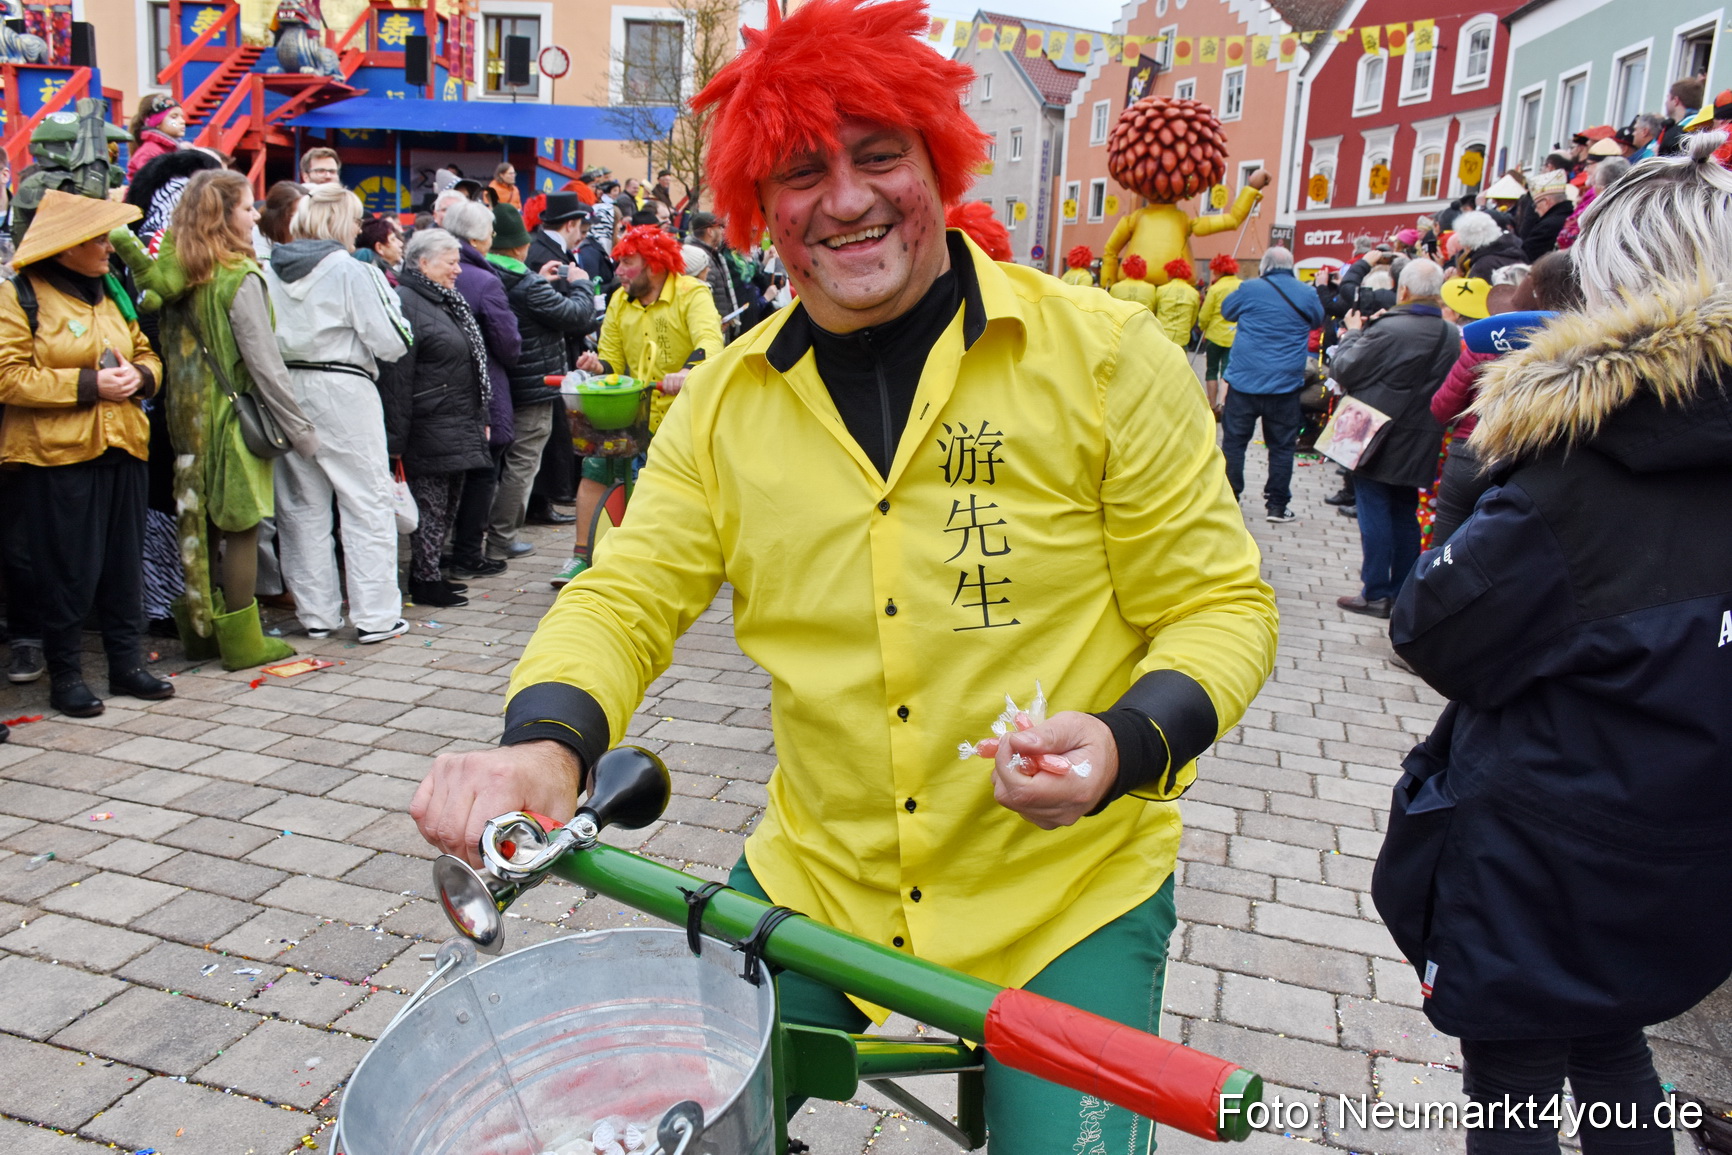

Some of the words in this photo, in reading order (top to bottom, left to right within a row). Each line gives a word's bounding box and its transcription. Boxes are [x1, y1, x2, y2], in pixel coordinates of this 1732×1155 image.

[1040, 140, 1050, 182] UHREN
[1035, 187, 1045, 245] SCHMUCK
[1271, 228, 1292, 240] CAFÉ
[1490, 327, 1513, 352] BR
[936, 419, 1021, 633] 游先生
